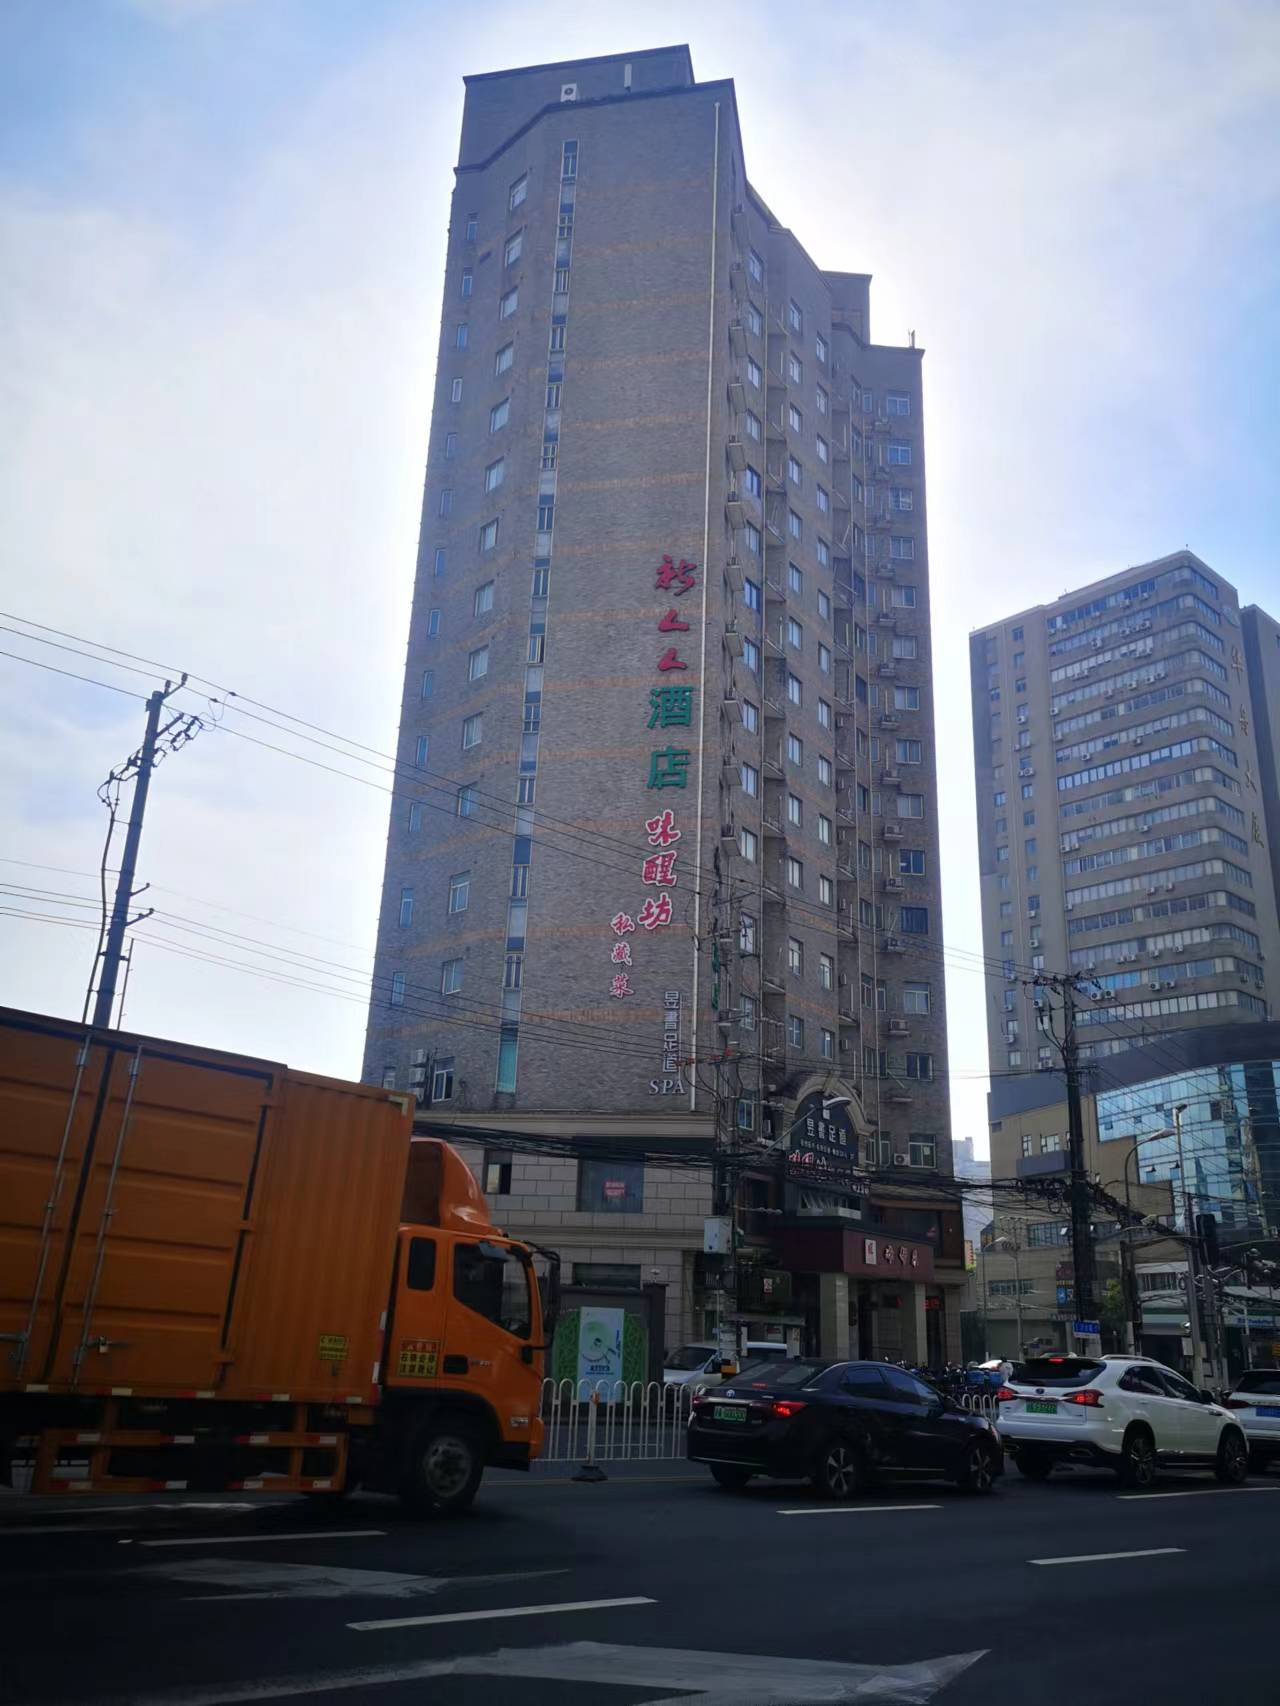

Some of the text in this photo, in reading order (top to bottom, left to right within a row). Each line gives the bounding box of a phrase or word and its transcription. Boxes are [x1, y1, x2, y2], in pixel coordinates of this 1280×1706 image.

[610, 911, 635, 999] 私藏菜
[648, 1078, 686, 1096] SPA
